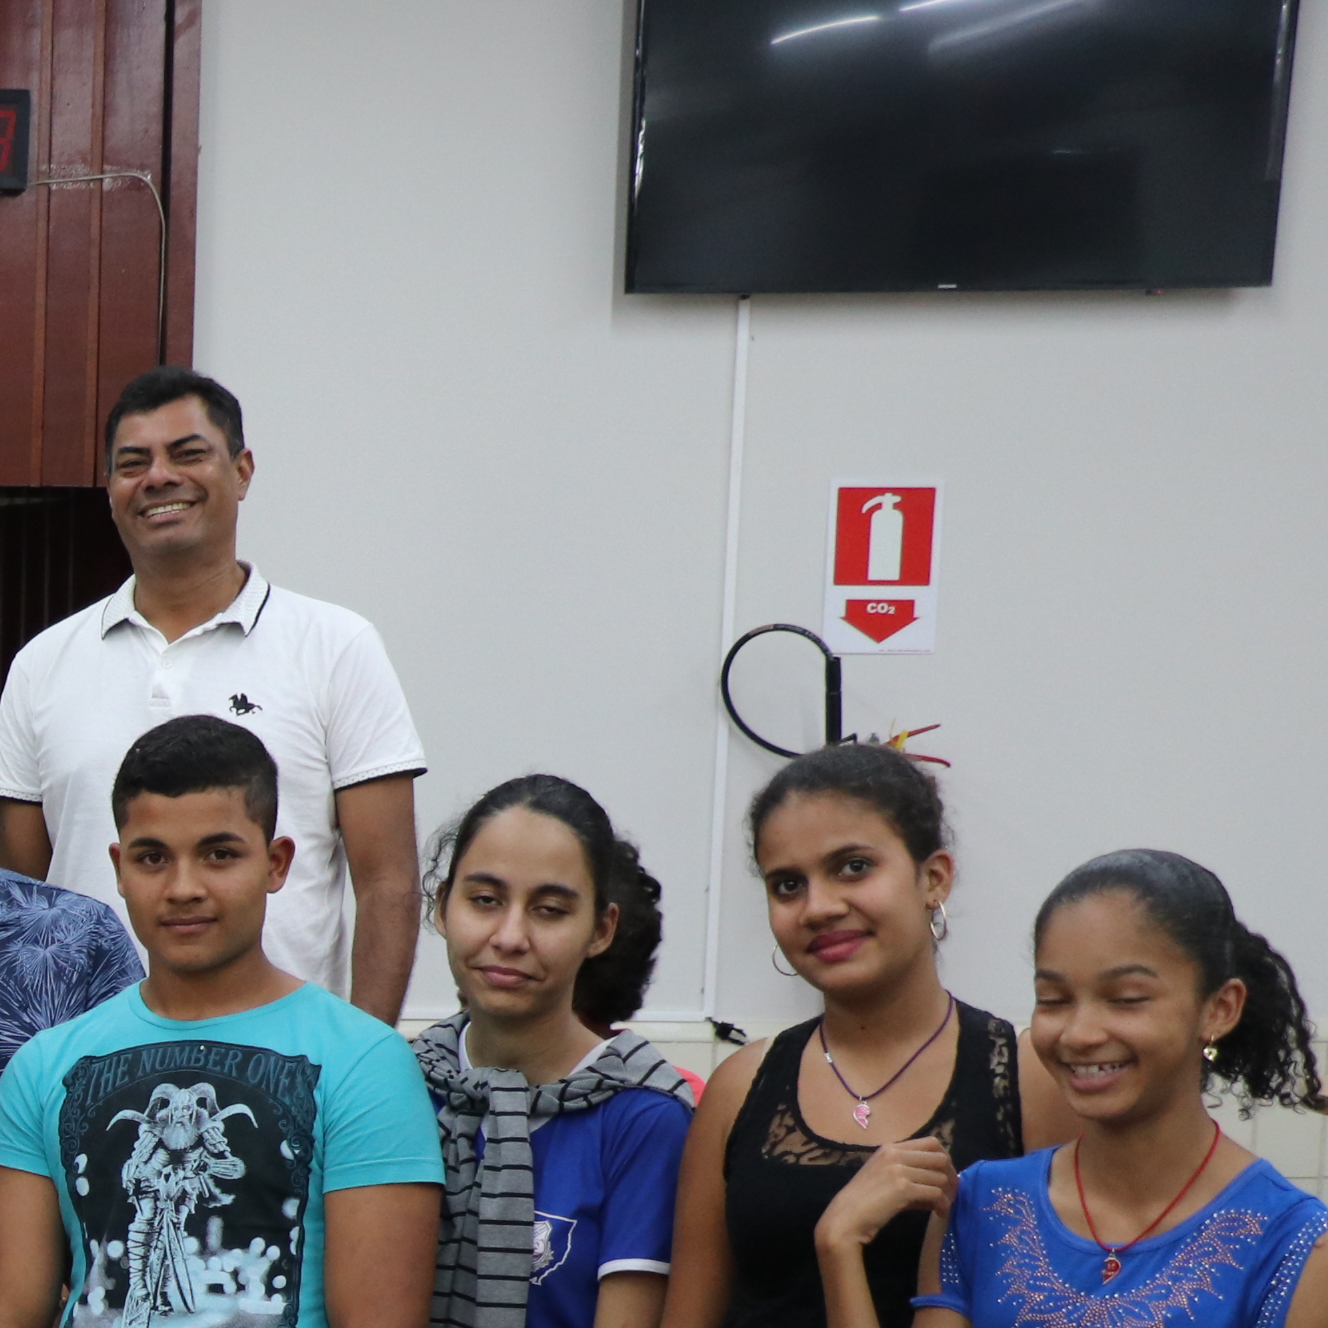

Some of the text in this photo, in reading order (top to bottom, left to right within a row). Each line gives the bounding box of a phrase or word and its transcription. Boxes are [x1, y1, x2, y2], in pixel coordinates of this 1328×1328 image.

[85, 1044, 300, 1107] THE NUMBER ONE
